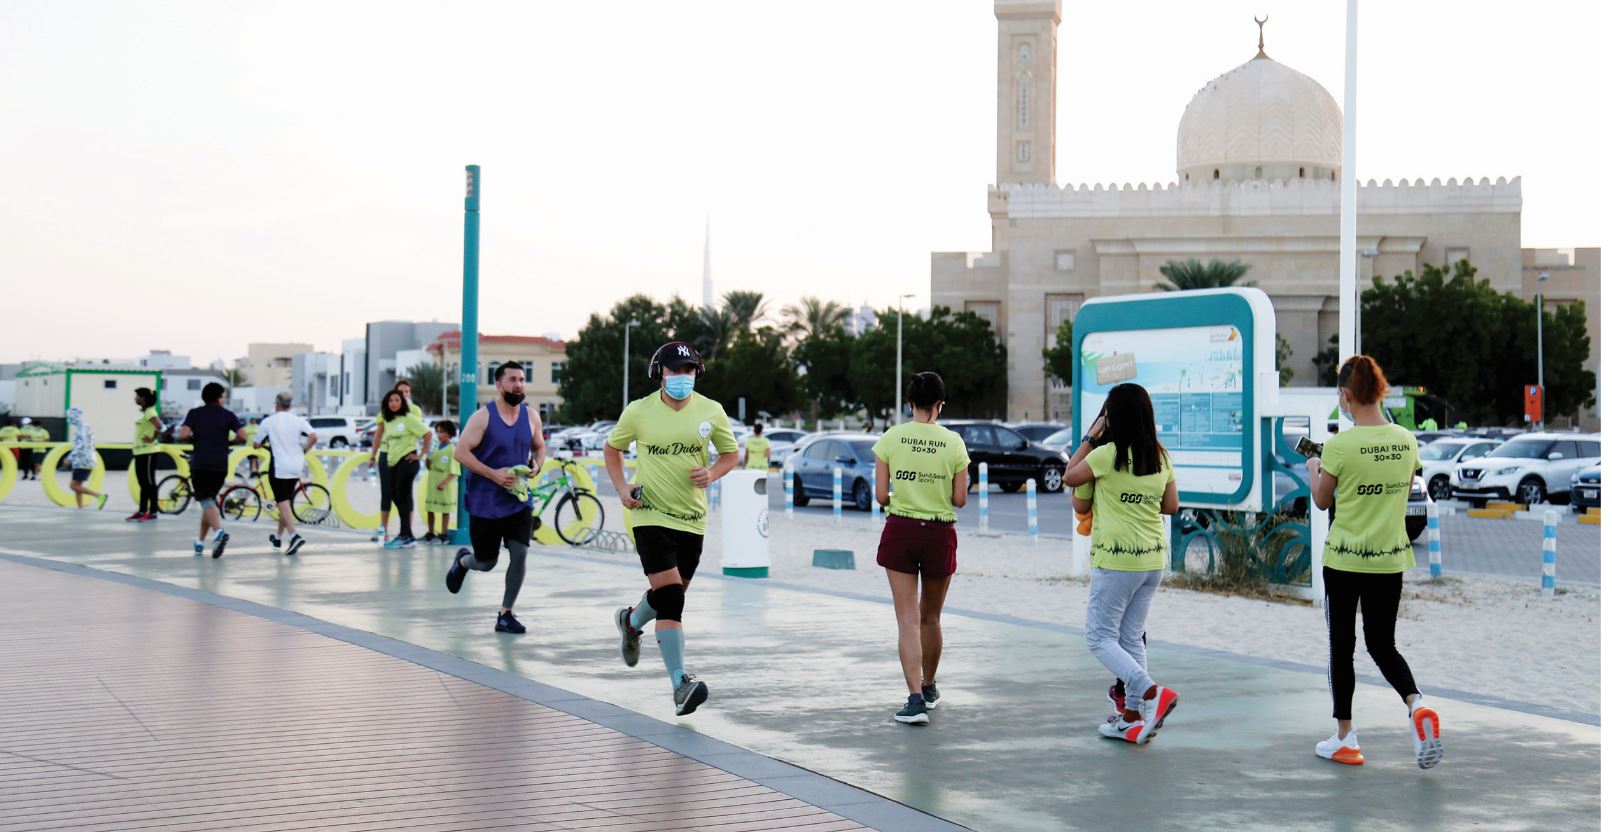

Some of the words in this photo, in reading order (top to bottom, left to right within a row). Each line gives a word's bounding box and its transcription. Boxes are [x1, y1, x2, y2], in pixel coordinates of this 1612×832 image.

[902, 438, 926, 446] DUBAI
[647, 445, 670, 455] Mai
[1360, 446, 1389, 454] DUBAI
